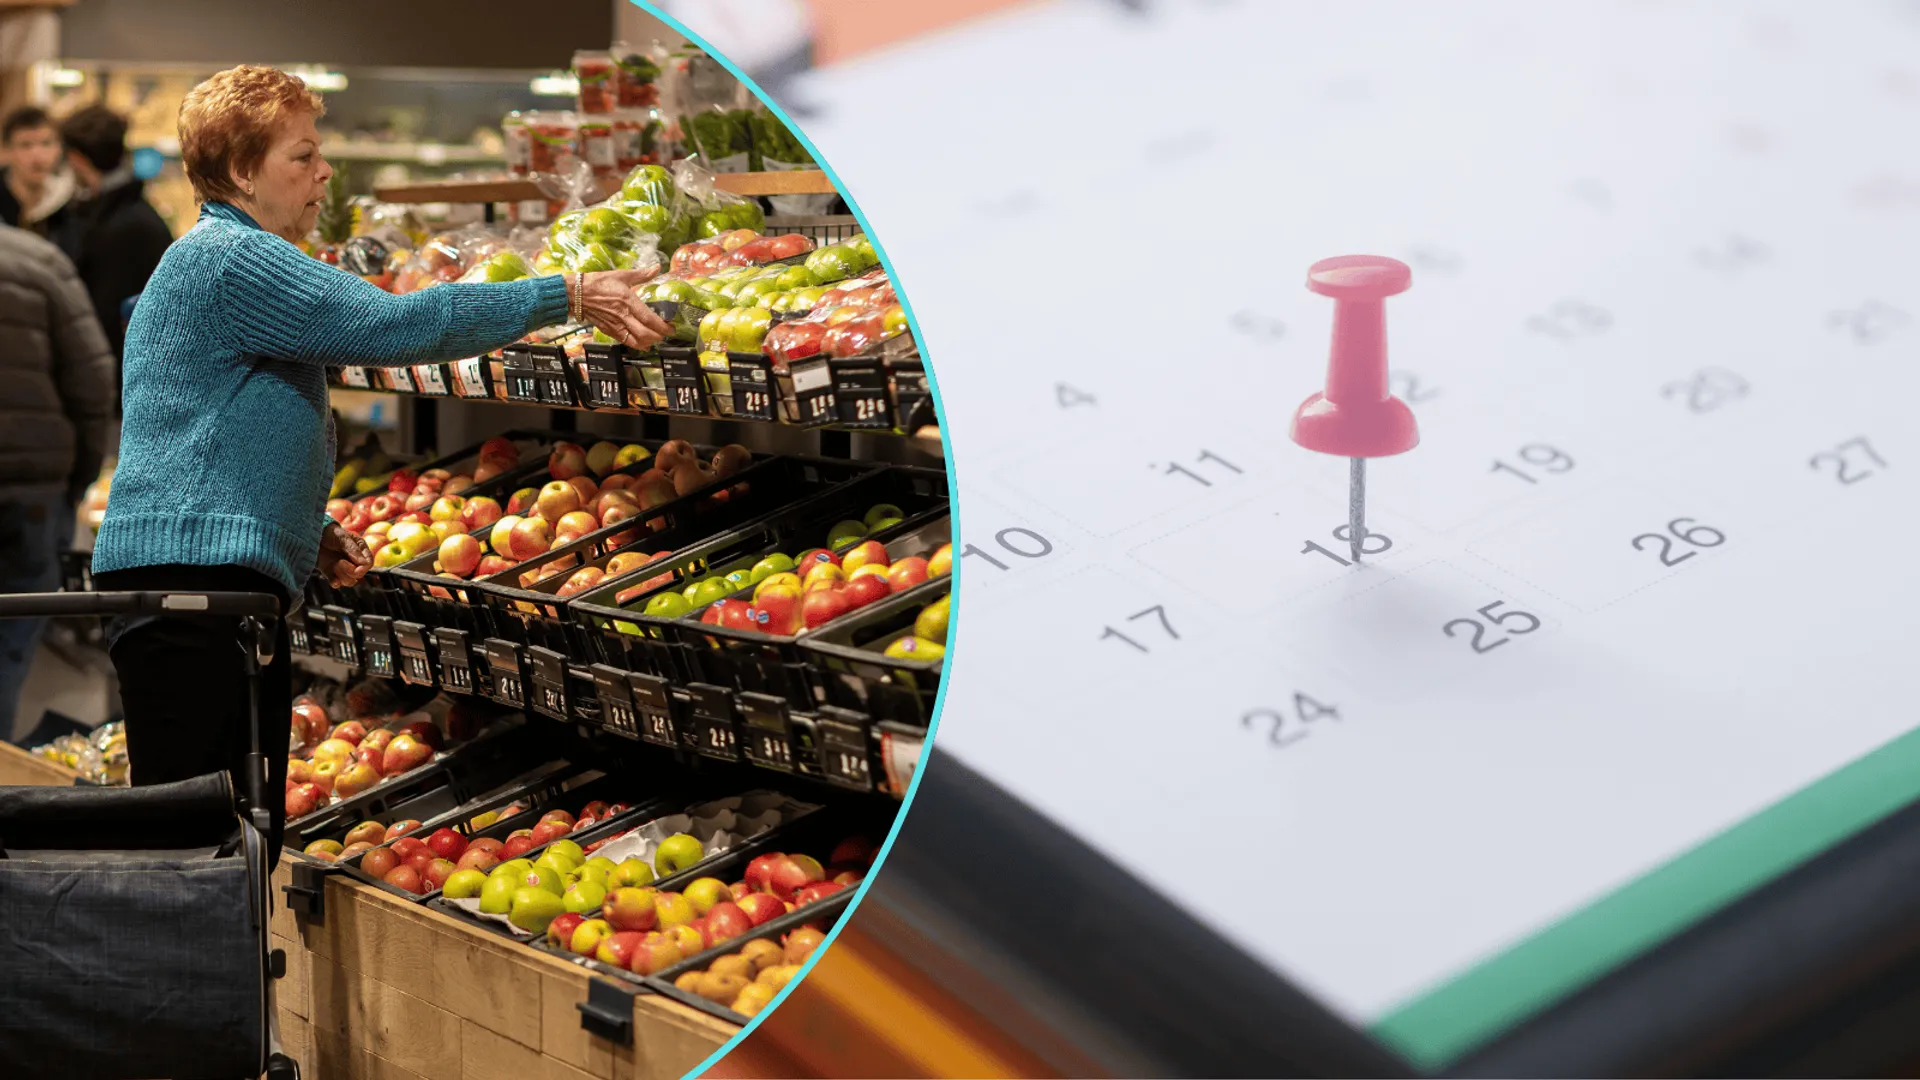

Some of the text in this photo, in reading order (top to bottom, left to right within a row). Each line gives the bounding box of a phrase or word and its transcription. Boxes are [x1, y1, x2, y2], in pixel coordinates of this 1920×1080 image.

[1054, 381, 1098, 410] 4
[1165, 448, 1244, 487] 11
[1489, 442, 1576, 485] 19
[1808, 435, 1888, 486] 27
[961, 526, 1053, 572] 10
[1300, 523, 1393, 567] 18
[1631, 517, 1726, 567] 26
[1100, 604, 1180, 653] 17
[1442, 600, 1541, 654] 25
[1241, 690, 1343, 749] 24
